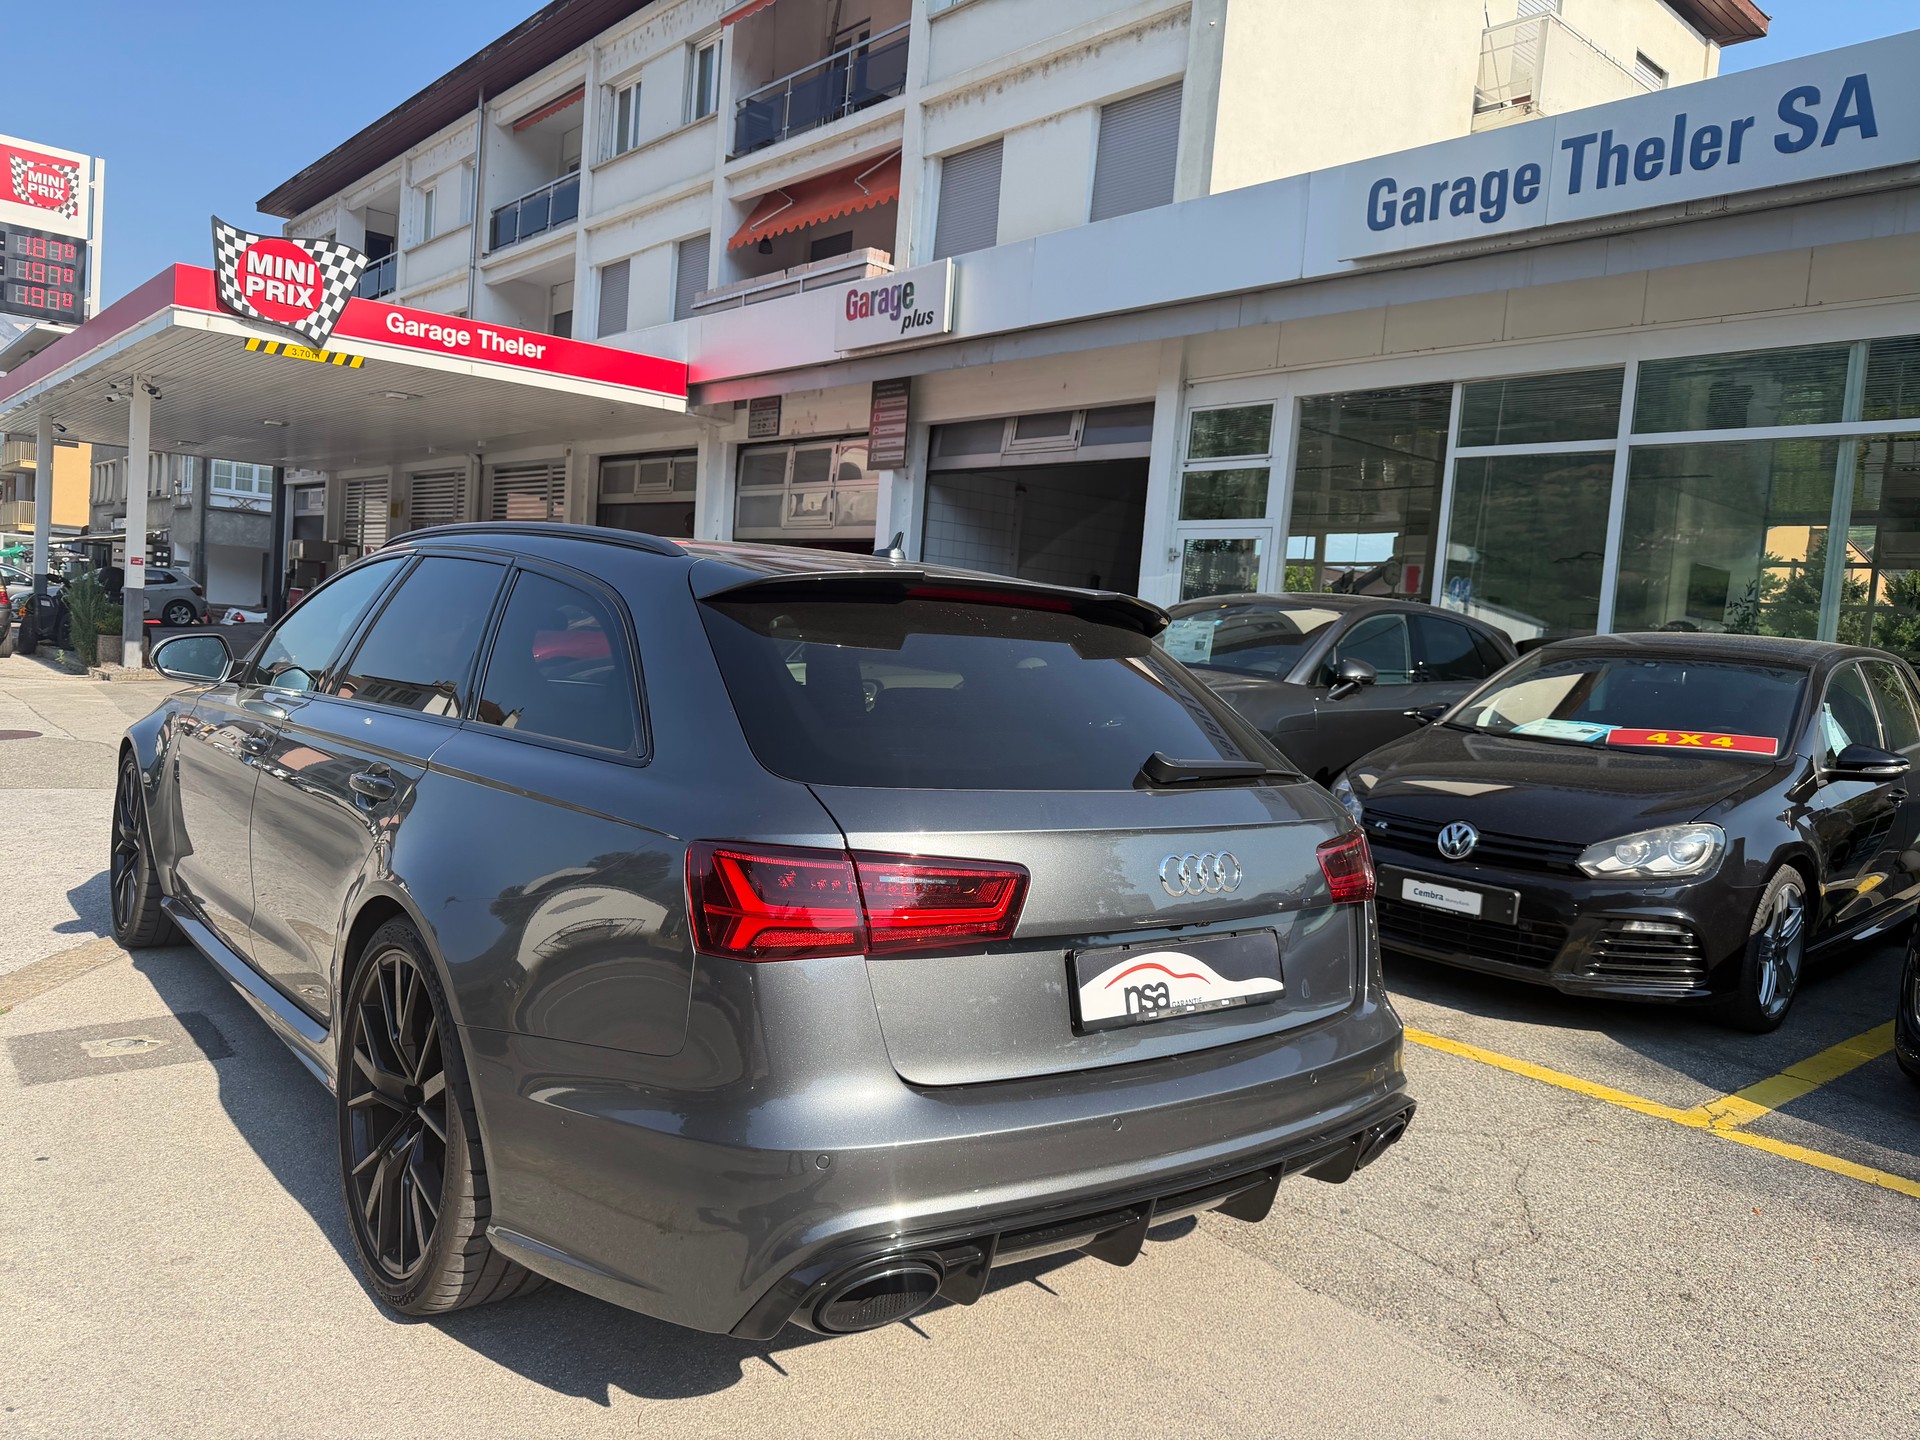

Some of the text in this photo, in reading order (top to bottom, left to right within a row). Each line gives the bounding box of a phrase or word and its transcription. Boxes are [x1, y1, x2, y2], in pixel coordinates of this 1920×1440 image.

[1367, 72, 1879, 233] Garage Theler SA
[27, 184, 65, 201] PRIX
[28, 170, 65, 189] MINI
[247, 250, 315, 286] MINI
[245, 275, 315, 310] PRIX
[846, 281, 915, 322] Garage
[386, 311, 547, 360] Garage Theler
[901, 309, 935, 334] plus
[1413, 887, 1444, 901] Cembra
[1124, 981, 1171, 1015] nsa
[1171, 997, 1203, 1008] GARANTIE
